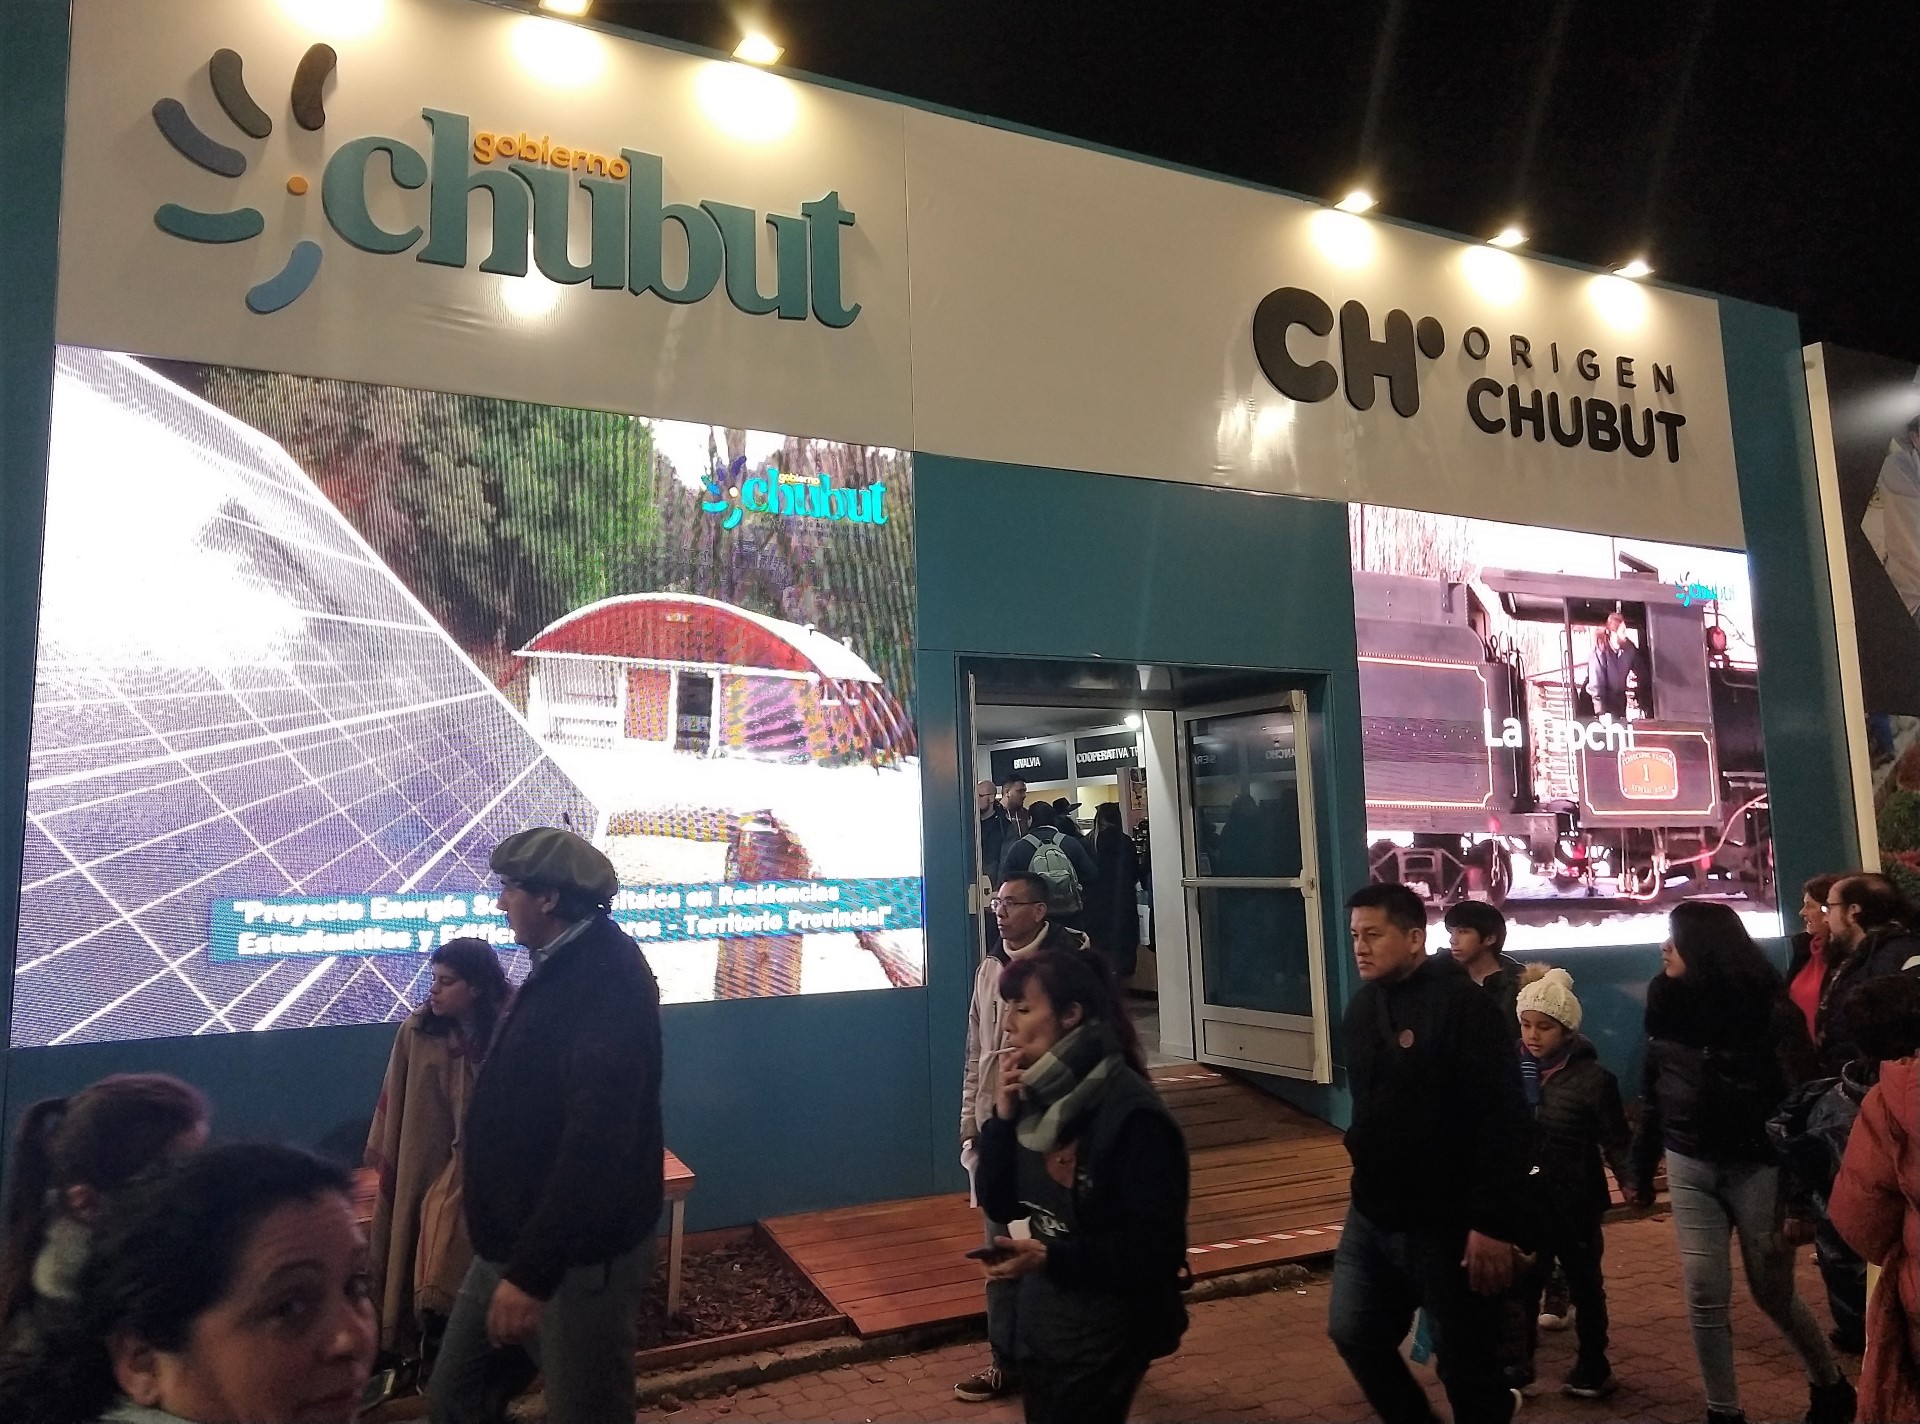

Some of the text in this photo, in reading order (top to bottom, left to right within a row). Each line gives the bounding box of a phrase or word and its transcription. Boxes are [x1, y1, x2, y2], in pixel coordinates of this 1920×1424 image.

[474, 132, 628, 180] gobierno
[322, 107, 860, 329] chubut
[1463, 326, 1675, 395] ORIGEN
[1466, 378, 1686, 463] CHUBUT
[741, 467, 888, 525] chubut
[1483, 708, 1523, 748] La
[1076, 747, 1129, 764] COOPERATIVA
[718, 883, 839, 905] Residencias
[417, 930, 435, 952] y
[684, 911, 783, 935] Territorio
